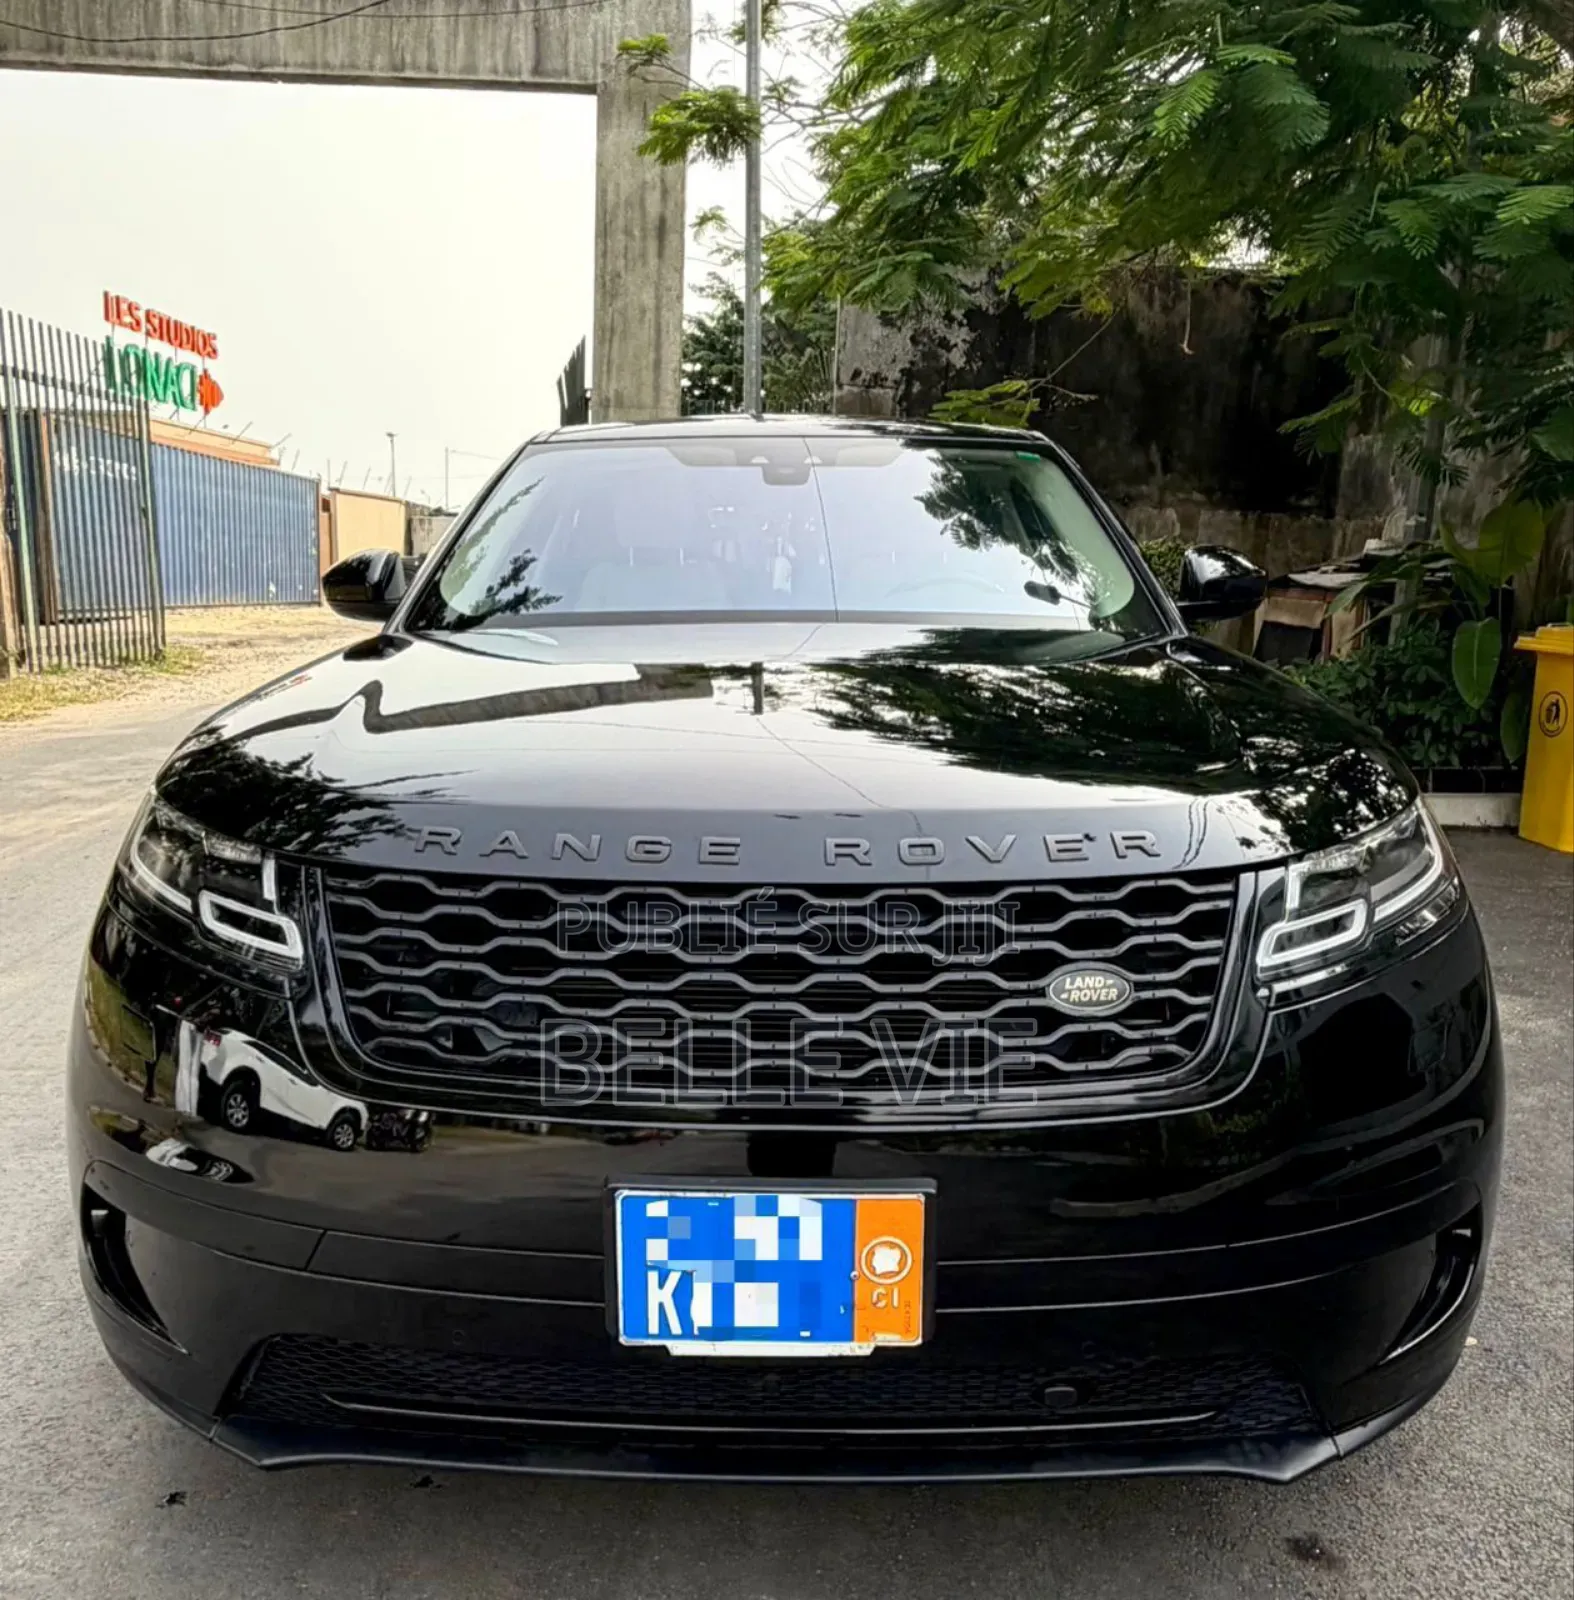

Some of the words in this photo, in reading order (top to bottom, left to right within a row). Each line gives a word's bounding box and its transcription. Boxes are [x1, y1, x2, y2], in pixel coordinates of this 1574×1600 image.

[103, 290, 142, 332] LES
[145, 308, 218, 360] STUDIOS
[414, 826, 741, 865] RANGE
[824, 830, 1161, 866] ROVER
[1064, 976, 1105, 989] LAND
[1069, 988, 1118, 1002] ROVER
[872, 1287, 899, 1309] CI
